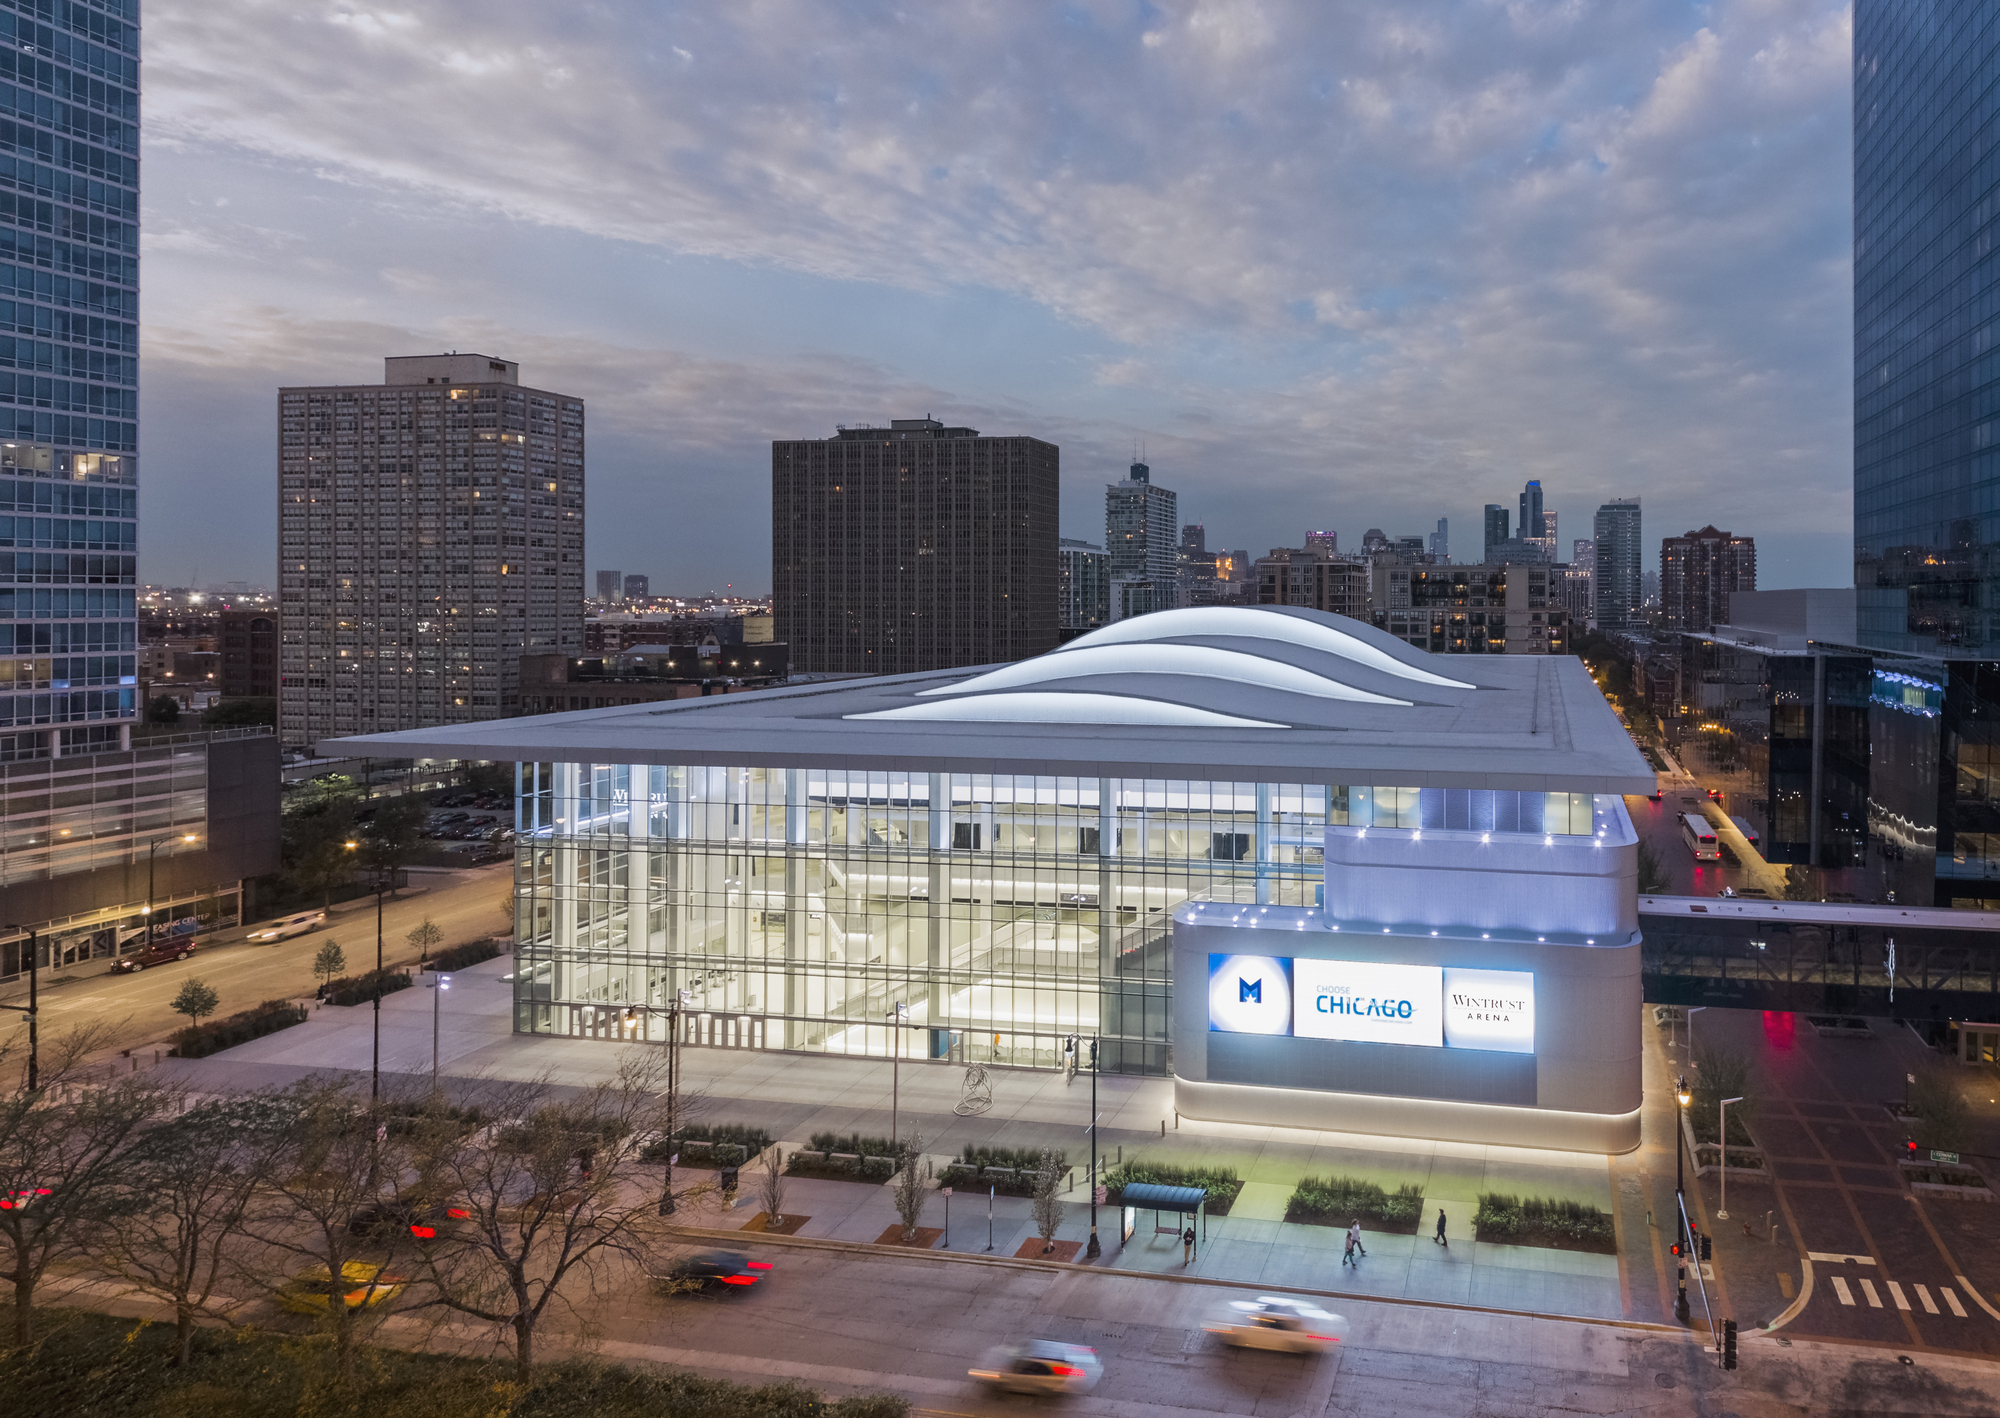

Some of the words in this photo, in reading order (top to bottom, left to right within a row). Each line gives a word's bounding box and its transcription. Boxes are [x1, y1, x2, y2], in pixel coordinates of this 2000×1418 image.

[152, 919, 181, 932] EASING
[1316, 984, 1351, 995] CHOOSE
[1316, 994, 1413, 1019] CHICAGO
[1453, 994, 1525, 1010] WINTRUST
[1467, 1012, 1510, 1022] ARENA
